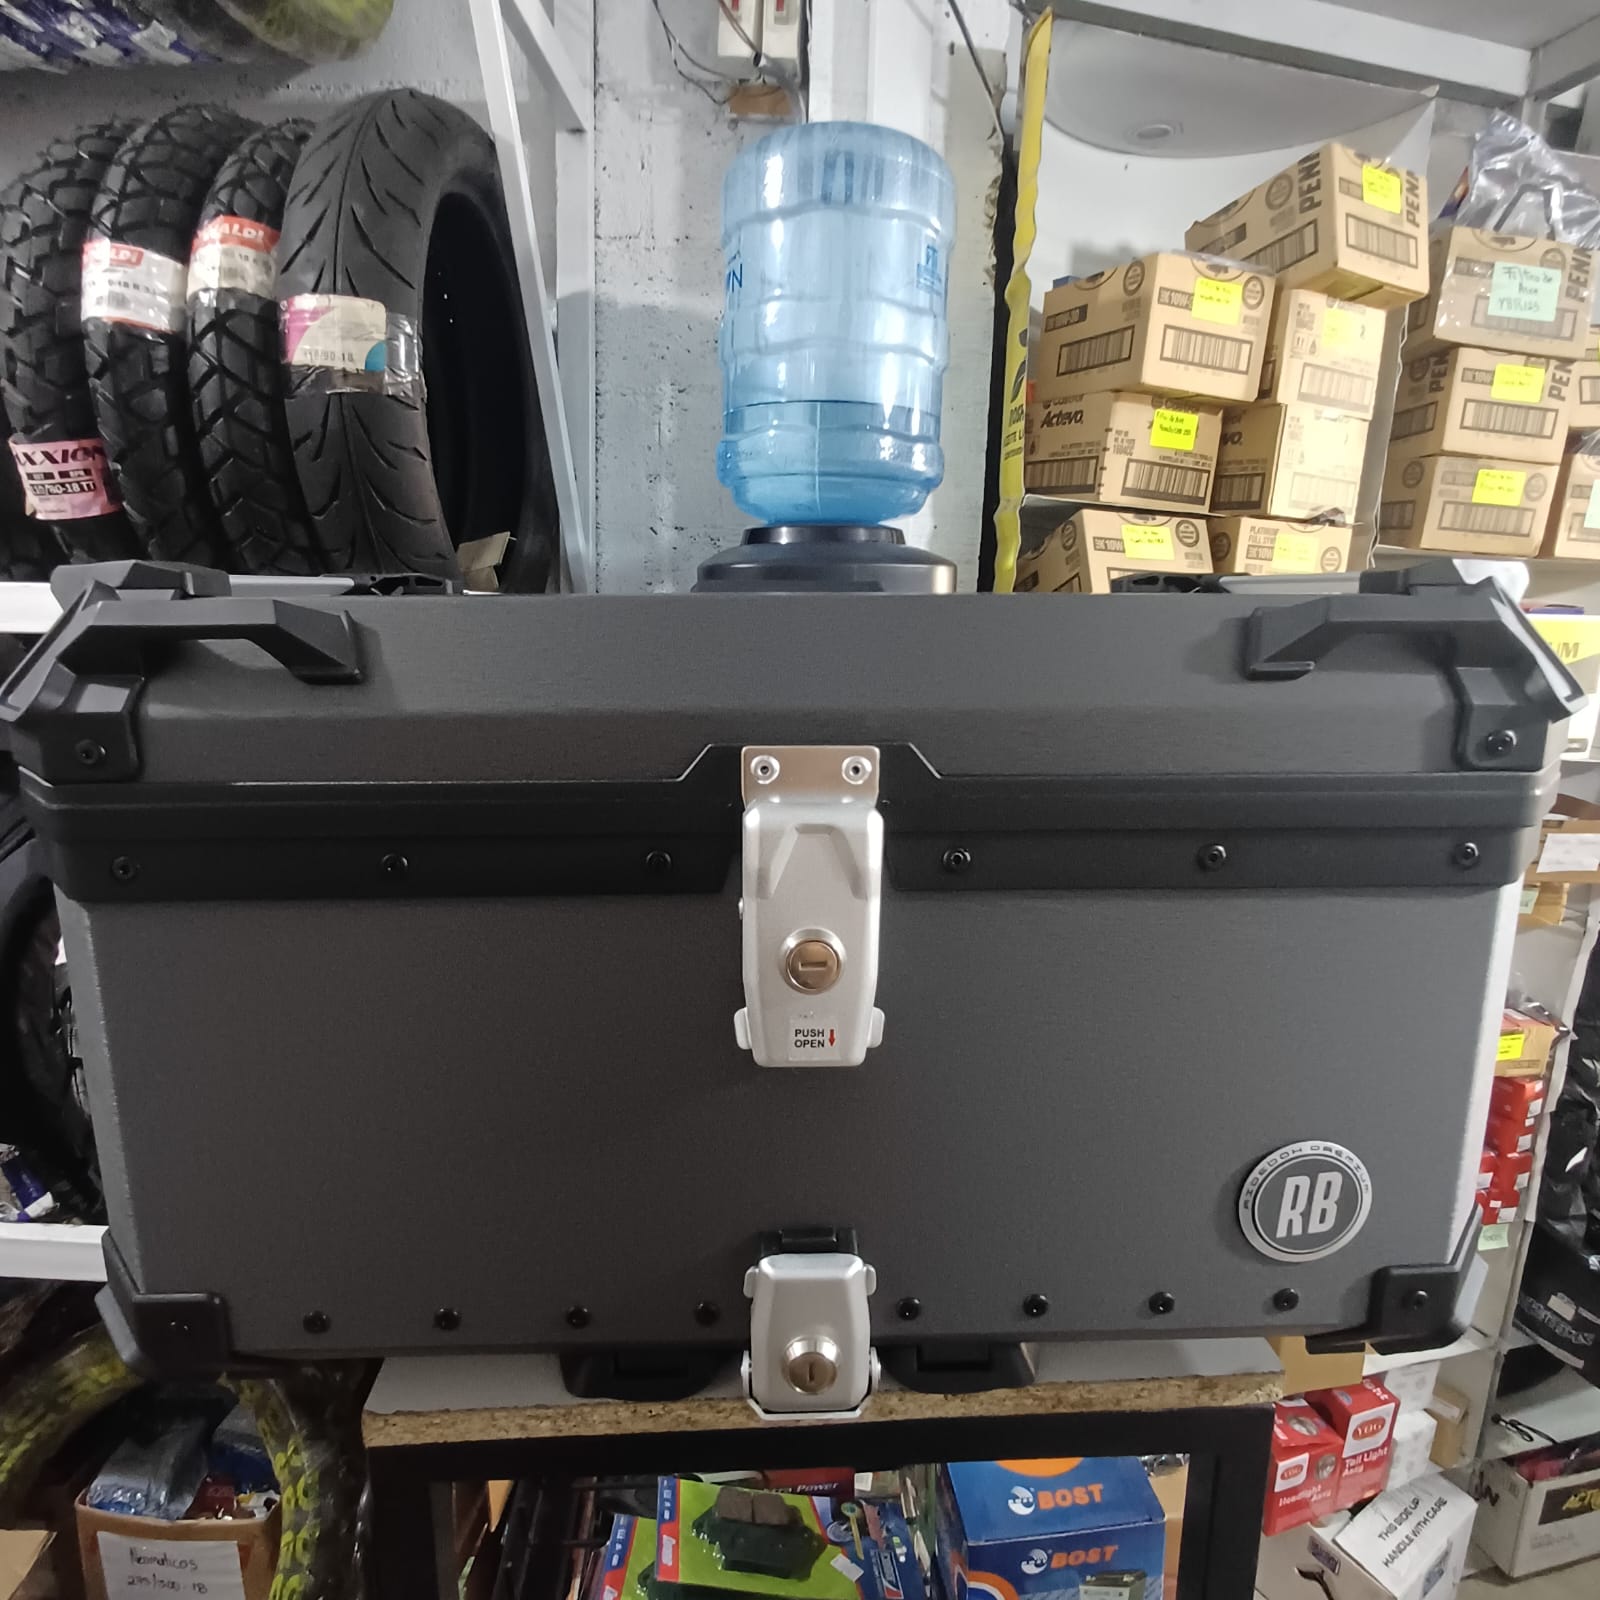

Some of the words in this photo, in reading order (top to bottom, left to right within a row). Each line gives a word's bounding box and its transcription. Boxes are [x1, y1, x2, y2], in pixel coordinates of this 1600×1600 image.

[794, 1028, 824, 1038] PUSH
[794, 1039, 825, 1048] OPEN
[1276, 1171, 1343, 1238] RB
[1363, 1447, 1388, 1462] Light
[797, 1482, 839, 1493] Power
[1037, 1483, 1104, 1510] BOST
[1377, 1522, 1398, 1541] THIS
[1393, 1507, 1413, 1527] SIDE
[1408, 1497, 1420, 1510] UP
[1382, 1534, 1415, 1568] HANDLE
[1411, 1516, 1431, 1538] WITH
[1426, 1497, 1448, 1519] CARE
[1051, 1545, 1118, 1569] BOST
